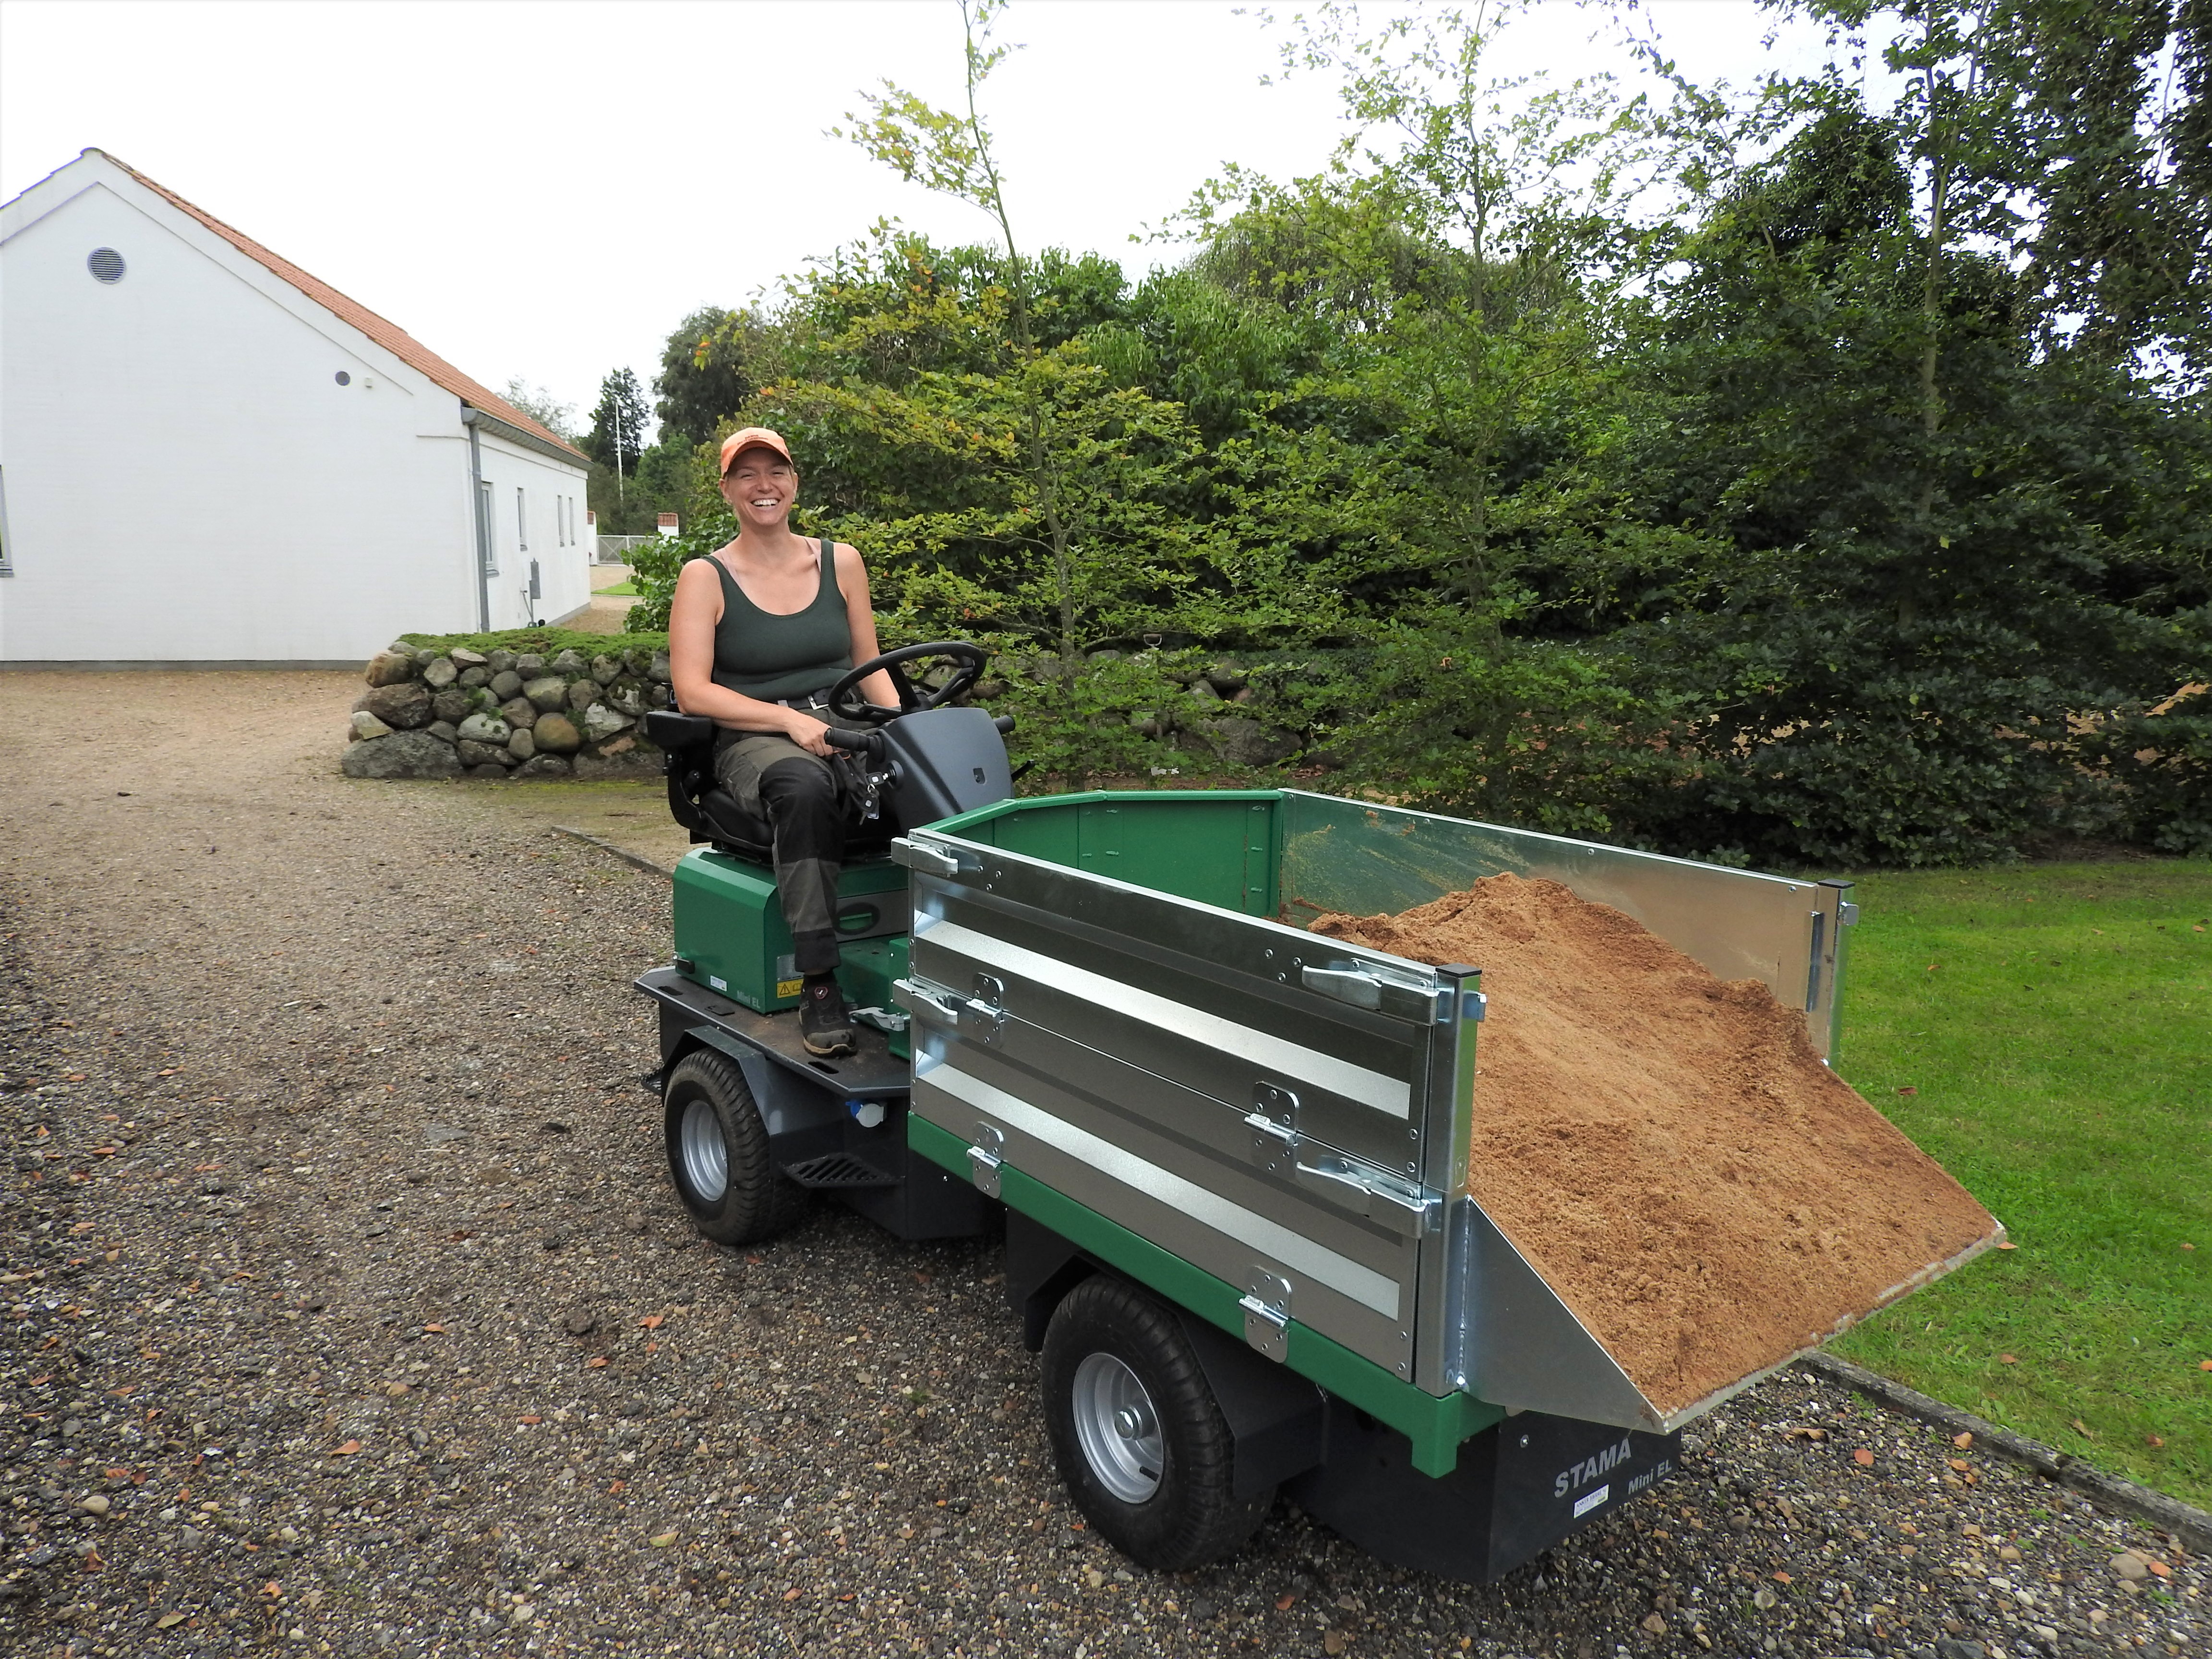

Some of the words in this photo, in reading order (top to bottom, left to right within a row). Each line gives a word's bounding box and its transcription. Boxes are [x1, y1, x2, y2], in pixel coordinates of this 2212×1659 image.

[751, 997, 760, 1009] EL
[1554, 1438, 1632, 1498] STAMA
[1628, 1468, 1654, 1495] Mini
[1657, 1459, 1672, 1478] EL
